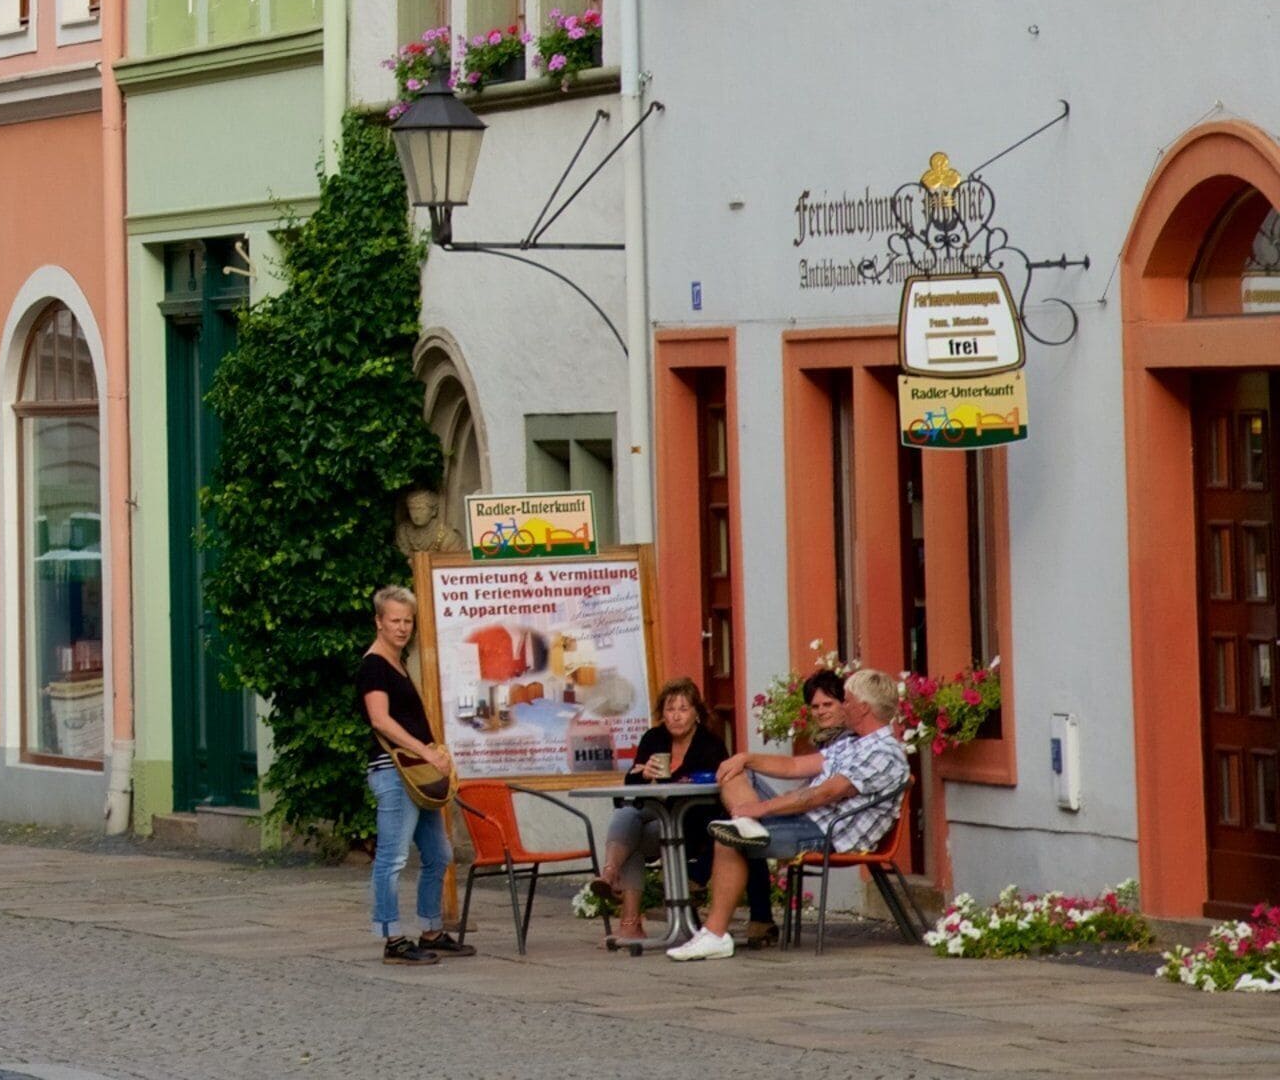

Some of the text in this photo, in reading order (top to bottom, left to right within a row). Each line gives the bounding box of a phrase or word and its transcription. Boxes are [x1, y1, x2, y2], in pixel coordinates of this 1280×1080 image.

[948, 338, 979, 356] frei
[911, 384, 1014, 401] Radler-Unterkunft
[476, 498, 586, 518] Radler-Unterkunft
[440, 566, 639, 587] Vermietung & Vermittlung
[442, 583, 612, 602] von Ferienwohnungen
[442, 601, 558, 620] & Appartement
[574, 748, 614, 762] HIER
